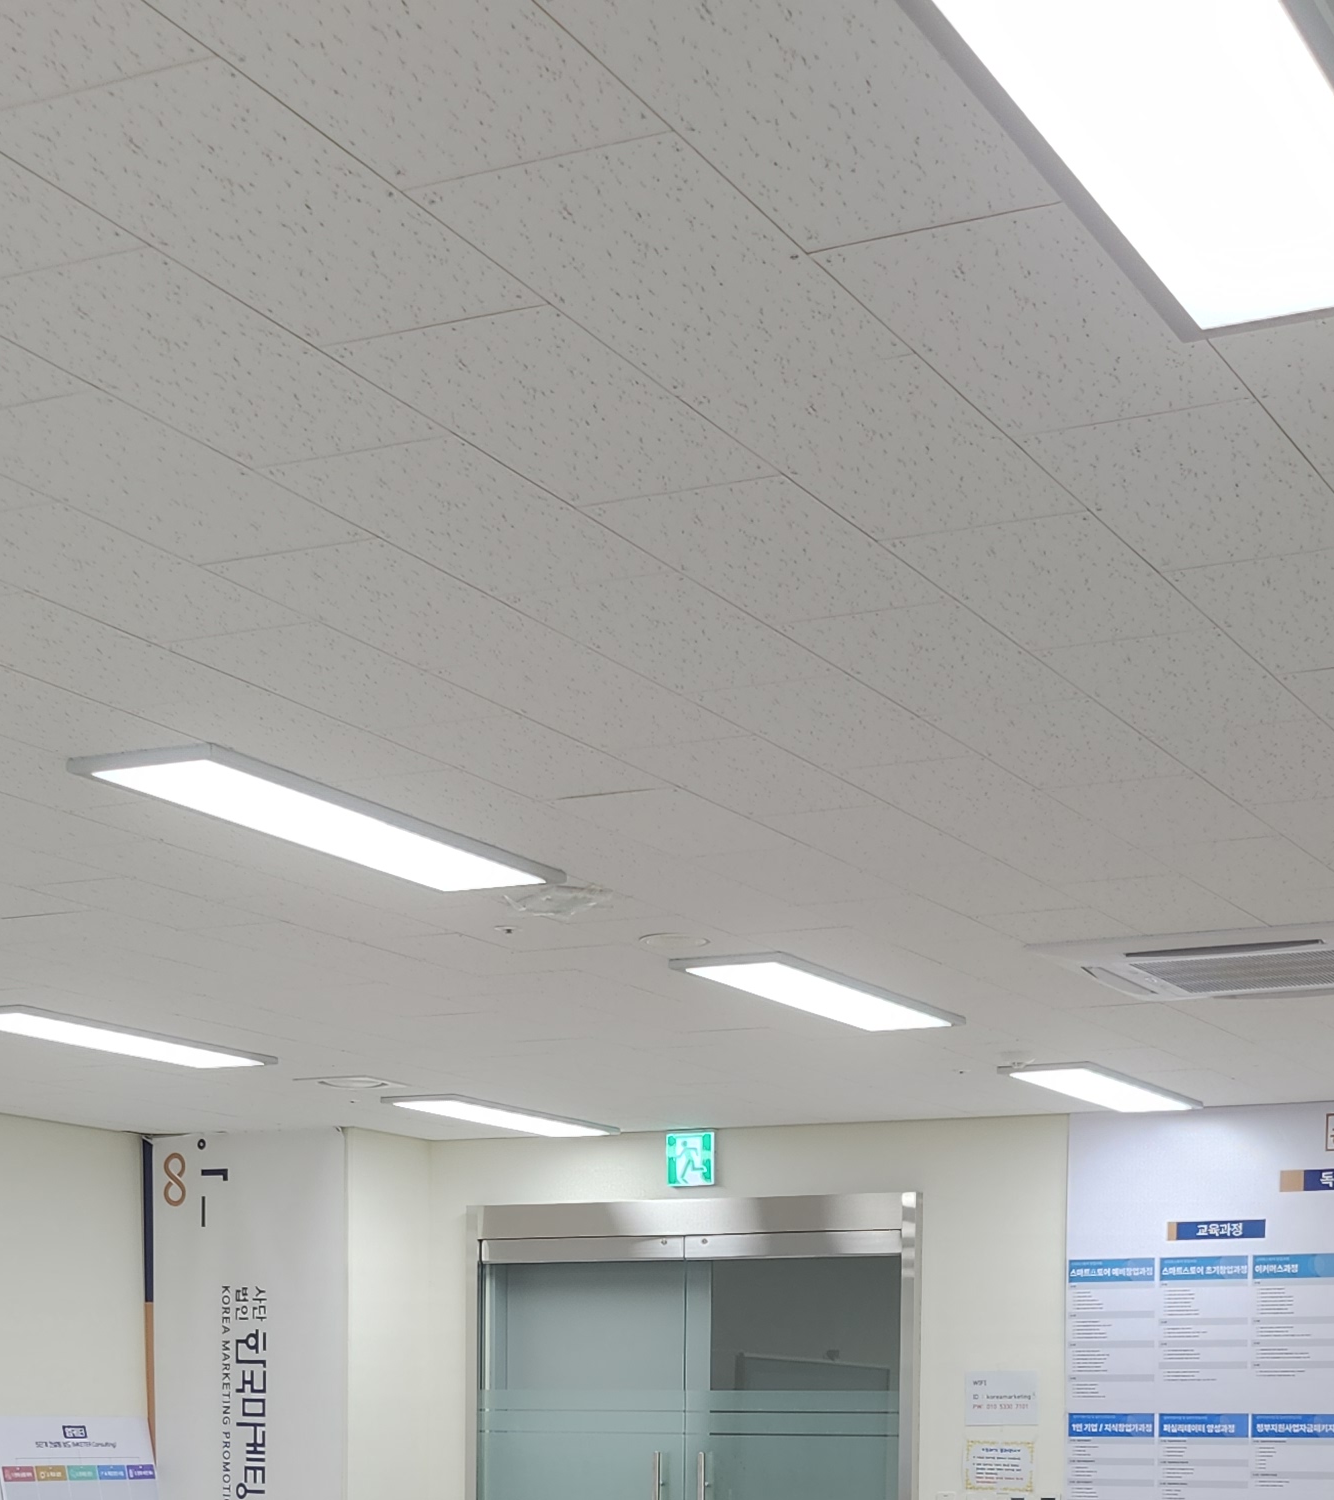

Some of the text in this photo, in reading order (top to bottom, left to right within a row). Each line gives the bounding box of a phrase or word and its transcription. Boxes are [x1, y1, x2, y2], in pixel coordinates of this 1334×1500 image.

[1195, 1222, 1244, 1237] 교육과정
[221, 1285, 231, 1335] KOREA
[235, 1286, 250, 1322] 법인
[252, 1285, 267, 1322] 사단
[221, 1340, 231, 1425] MARKETING
